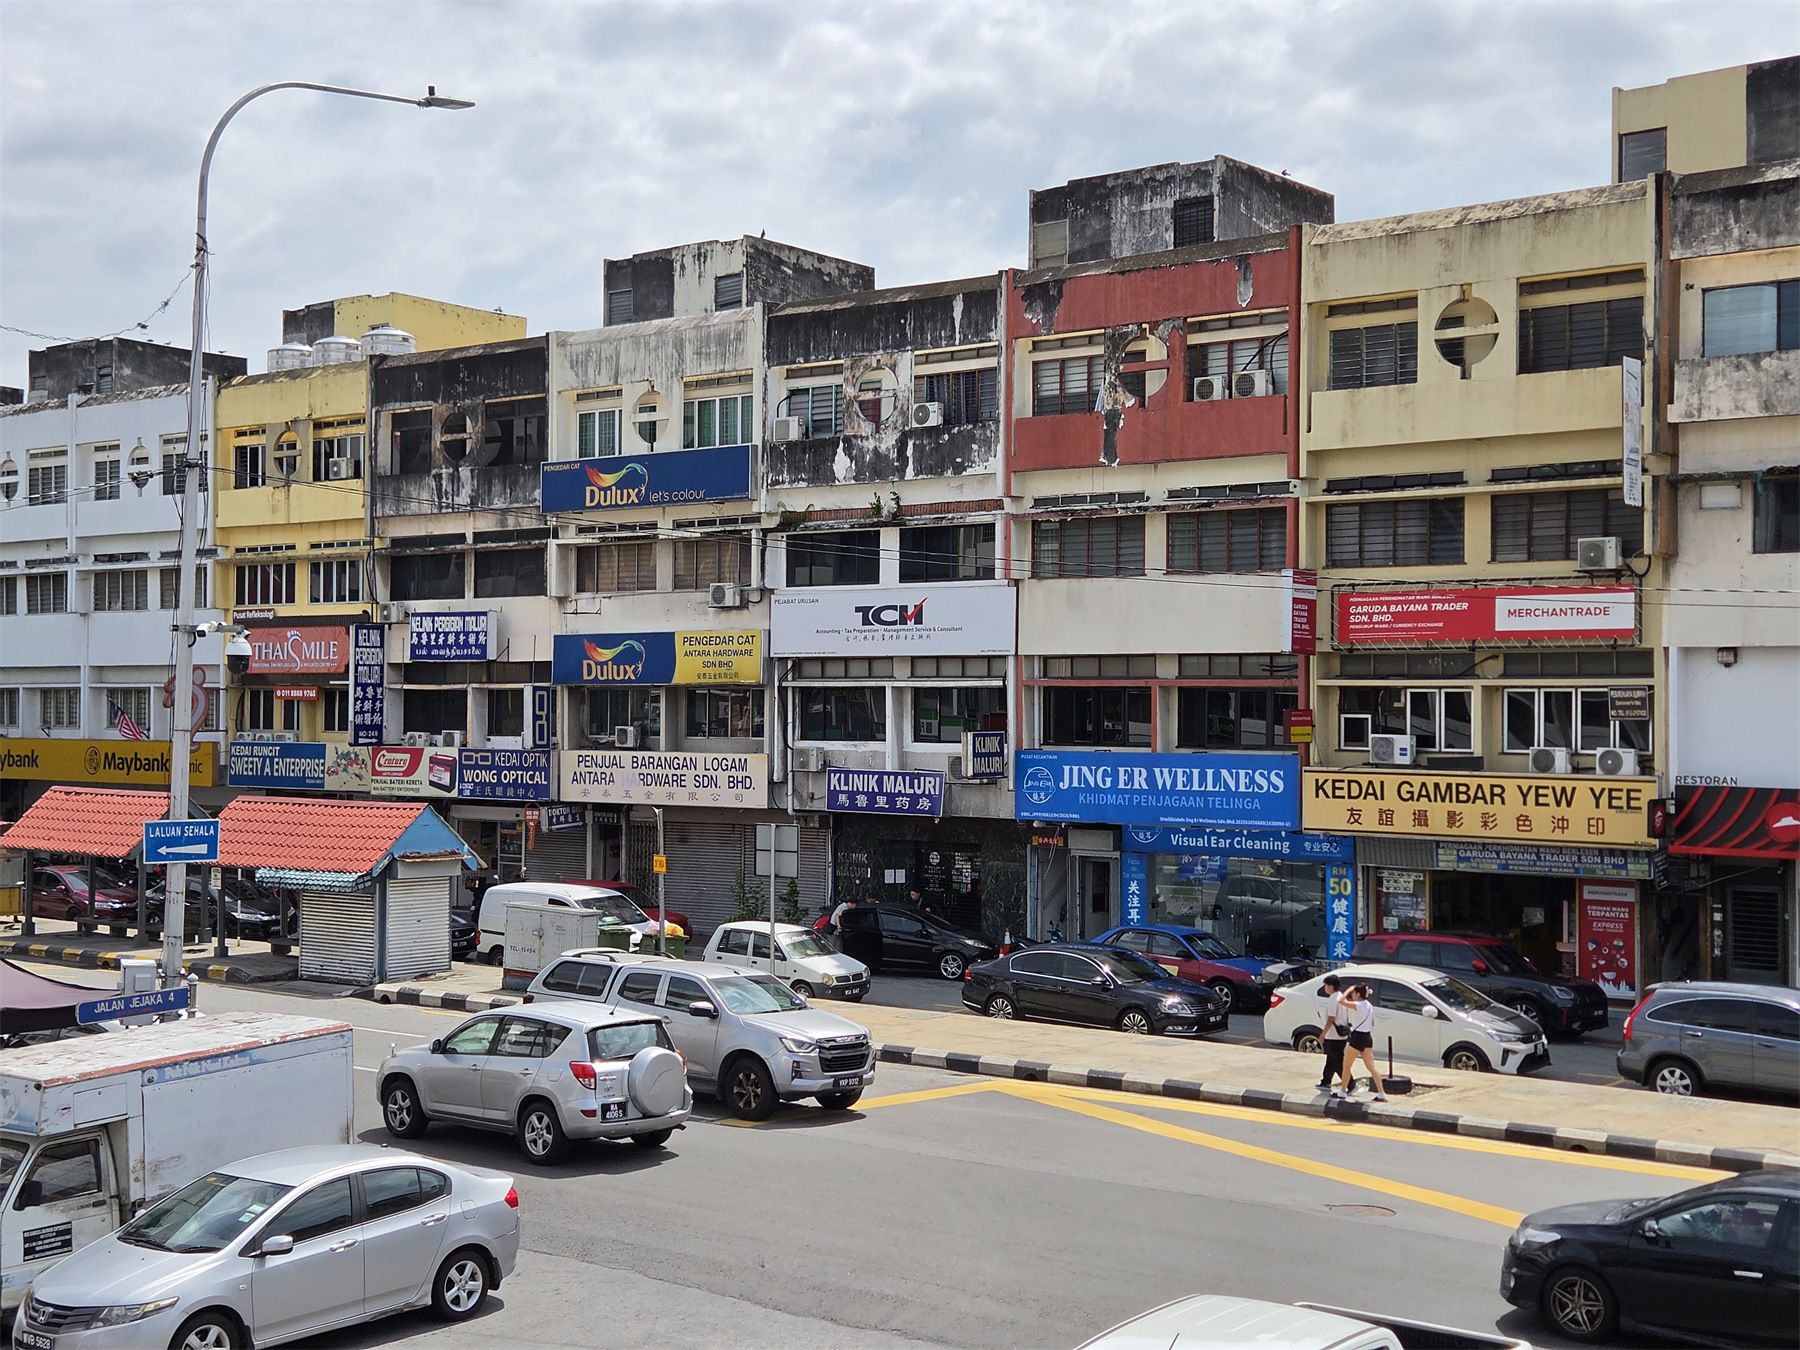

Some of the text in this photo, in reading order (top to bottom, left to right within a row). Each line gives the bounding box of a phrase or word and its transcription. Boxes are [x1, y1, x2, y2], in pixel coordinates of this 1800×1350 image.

[543, 464, 570, 472] PENGEDAR
[585, 485, 639, 507] Dulux
[649, 488, 706, 503] let's colour
[233, 610, 274, 619] Pusat Refleksologi
[1349, 602, 1468, 613] GARUDA BAYANA TRADER
[1507, 606, 1610, 618] MERCHANTRADE
[465, 616, 487, 632] MALURI
[1349, 614, 1394, 623] SDN. BHD.
[883, 627, 914, 635] Management
[682, 635, 756, 646] PENGEDAR CAT
[712, 649, 753, 657] HARDWARE
[583, 660, 636, 681] Dulux
[702, 660, 734, 669] SDN BHD
[231, 746, 280, 756] KEDAI RUNCIT
[975, 736, 1000, 752] KLINIK
[103, 752, 170, 776] Maybank
[377, 753, 408, 768] Century
[495, 752, 548, 767] KEDAI OPTIK
[577, 754, 748, 773] PENJUAL BARANGAN LOGAM
[973, 757, 1003, 774] MALURI
[230, 757, 324, 778] SWEETY A ENTERPRISE
[463, 769, 548, 784] WONG OPTICAL
[571, 771, 615, 785] ANTARA
[693, 775, 721, 790] SDN.
[727, 776, 755, 791] BHD.
[830, 773, 940, 795] KLINIK MALURI
[1060, 765, 1285, 794] JING ER WELLNESS
[1675, 775, 1738, 786] RESTORAN
[836, 793, 932, 811] 馬魯里药房
[1079, 793, 1261, 810] KHIDMAT PENJAGAAN TELINGA
[1315, 778, 1643, 811] KEDAI GAMBAR YEW YEE
[548, 807, 570, 816] DOKTOR
[1346, 807, 1606, 836] 友誼攝影彩色沖印
[150, 825, 215, 837] LALUAN SEHALA
[1171, 834, 1290, 854] Visual Ear Cleaning
[1440, 842, 1482, 850] PERNIAGAAN
[1562, 848, 1599, 856] BERLESEN
[838, 852, 868, 864] KLINIK
[1459, 850, 1625, 865] GARUDA BAYANA TRADER SDN BHD
[836, 867, 871, 878] MALURI
[1332, 867, 1347, 876] RM
[1329, 878, 1351, 895] 50
[1127, 880, 1141, 925] 关注耳
[1587, 910, 1629, 919] TERPANTAS
[1593, 921, 1624, 929] EXPRESS
[94, 1000, 124, 1013] JALAN
[129, 995, 163, 1008] JEJAKA
[168, 992, 174, 1002] 4
[36, 1335, 50, 1349] 5628
